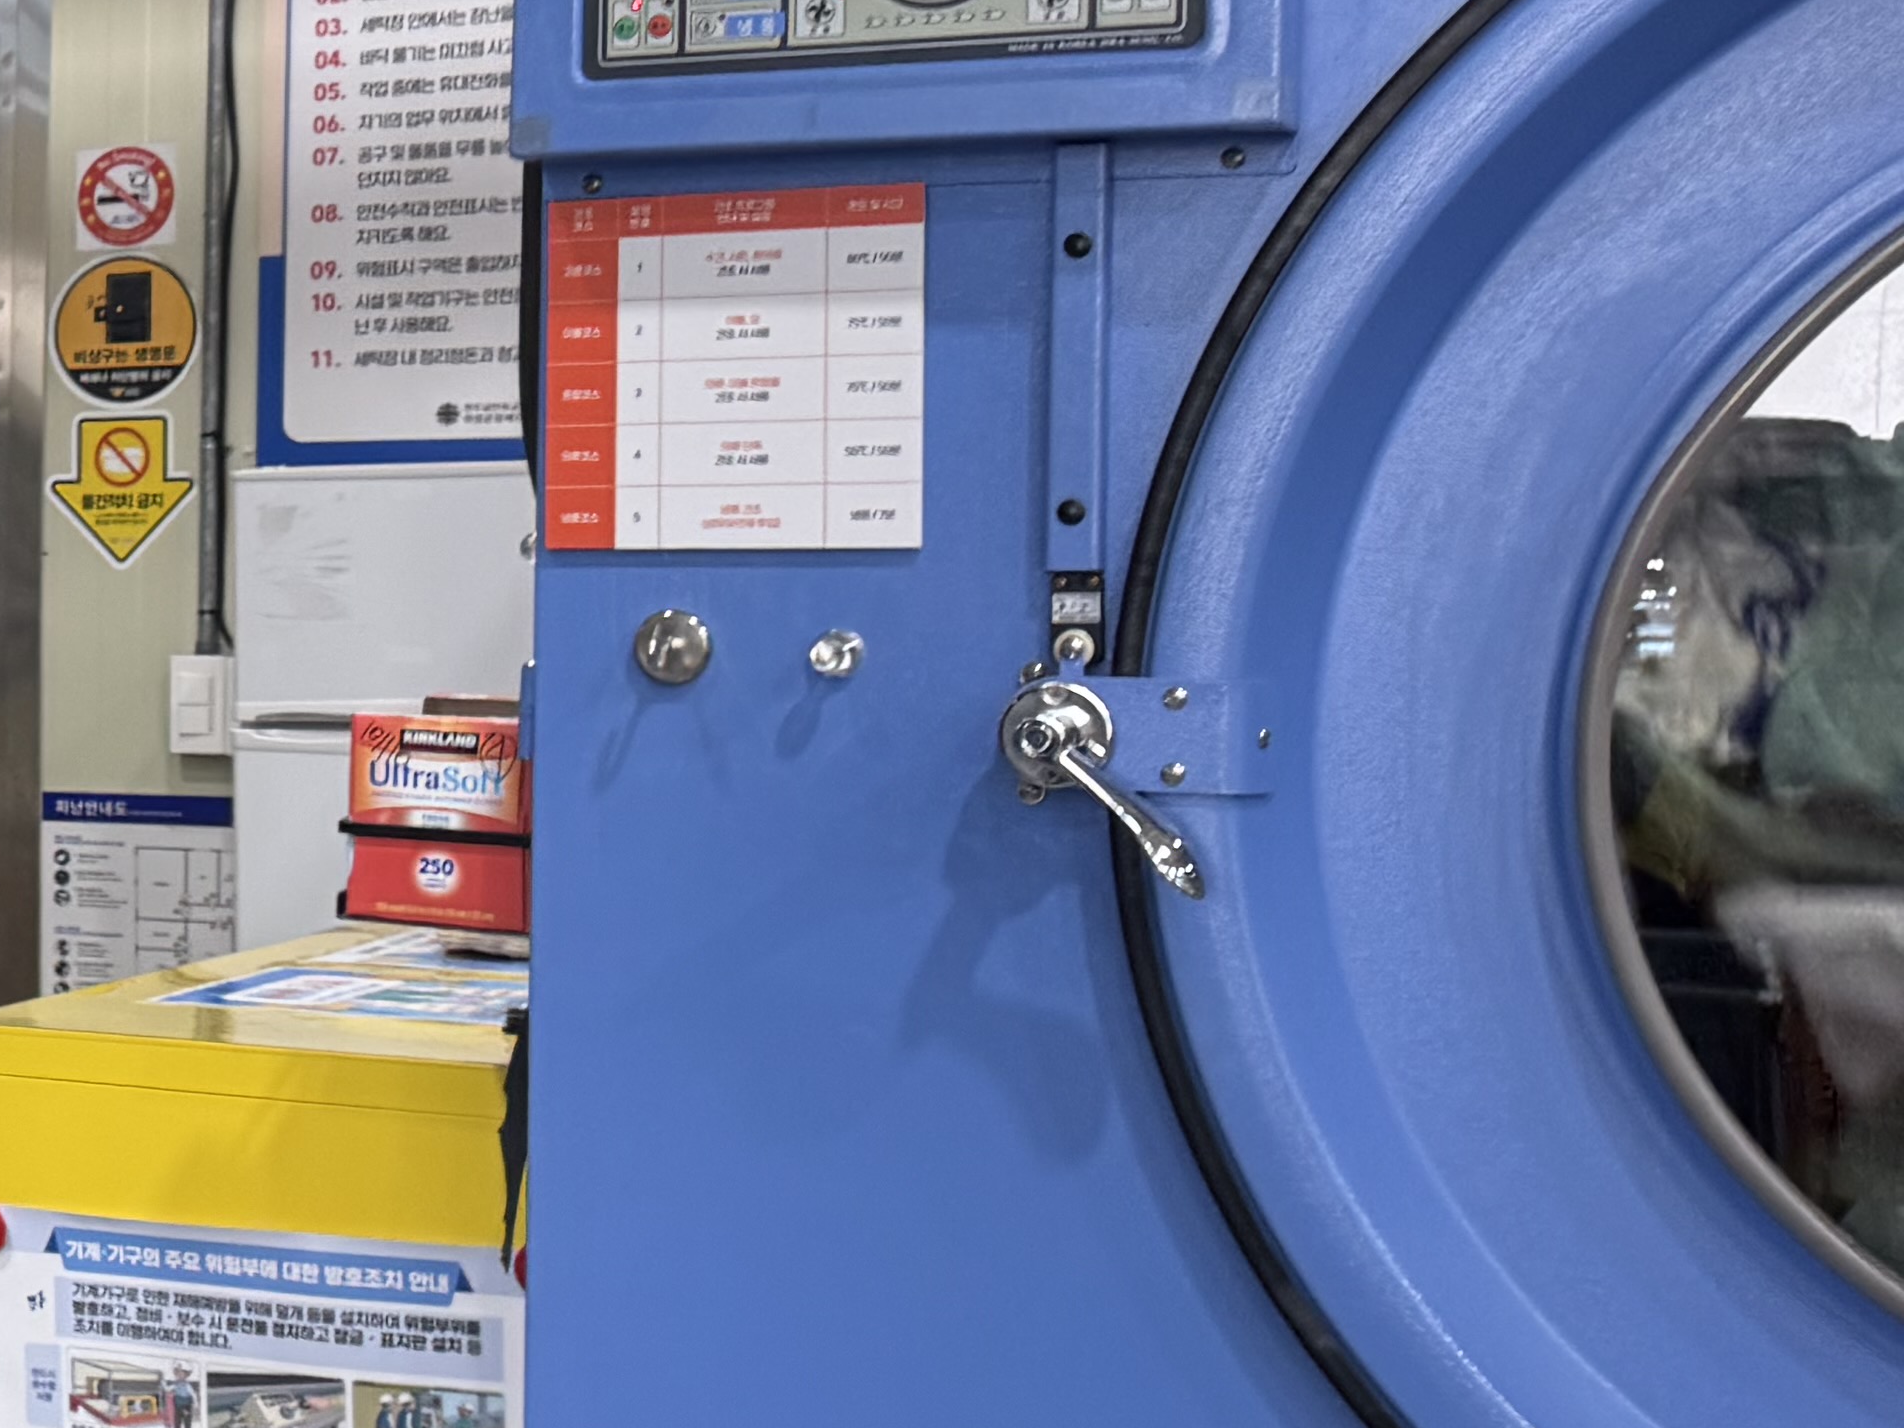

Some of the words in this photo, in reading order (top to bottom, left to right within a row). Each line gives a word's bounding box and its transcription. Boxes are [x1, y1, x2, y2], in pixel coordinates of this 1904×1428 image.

[315, 18, 348, 37] 03.
[315, 50, 347, 70] 04.
[314, 82, 346, 102] 05.
[313, 115, 345, 134] 06.
[312, 146, 345, 166] 07.
[311, 204, 343, 223] 08.
[310, 260, 343, 280] 09.
[311, 292, 342, 312] 10.
[311, 349, 342, 369] 11.
[403, 729, 478, 750] KIRKLAND
[369, 759, 504, 797] UltraSoft
[419, 857, 455, 877] 250
[65, 1239, 161, 1269] 기계·기구의
[164, 1249, 202, 1272] 주요
[206, 1253, 279, 1281] 위험부에
[282, 1261, 319, 1284] 대한
[324, 1264, 405, 1291] 방호조치
[408, 1272, 451, 1295] 안내
[339, 1309, 401, 1331] 설치하여
